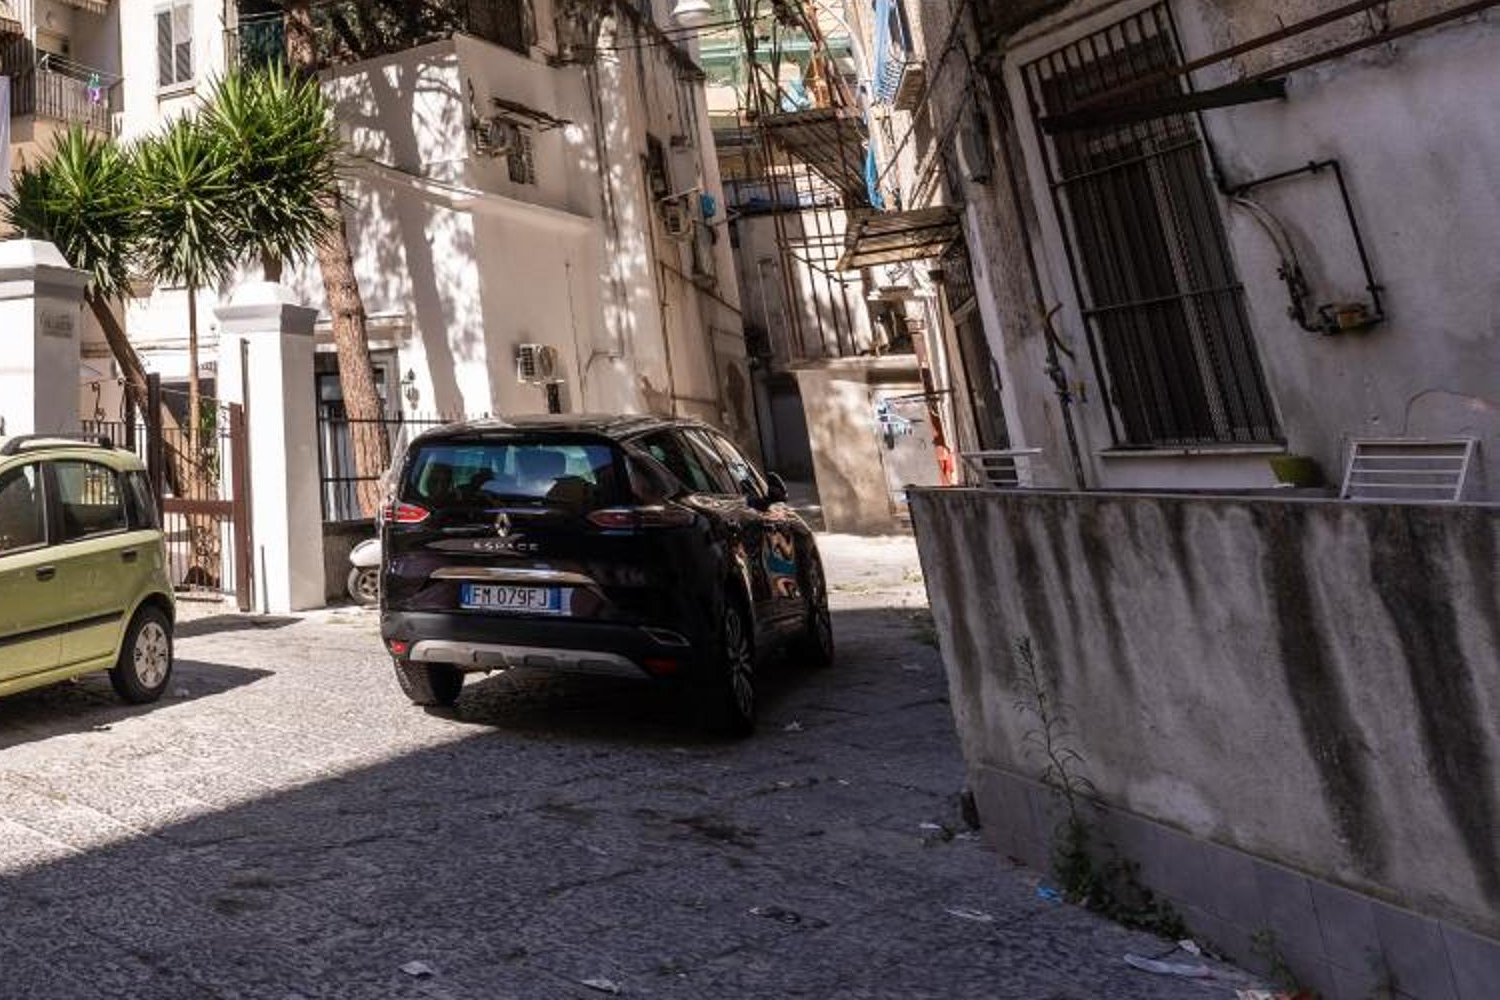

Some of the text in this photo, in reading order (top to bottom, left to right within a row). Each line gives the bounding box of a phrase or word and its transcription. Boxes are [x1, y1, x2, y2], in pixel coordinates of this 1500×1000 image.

[473, 541, 539, 552] ESPACE
[473, 586, 548, 609] FM 079FJ
